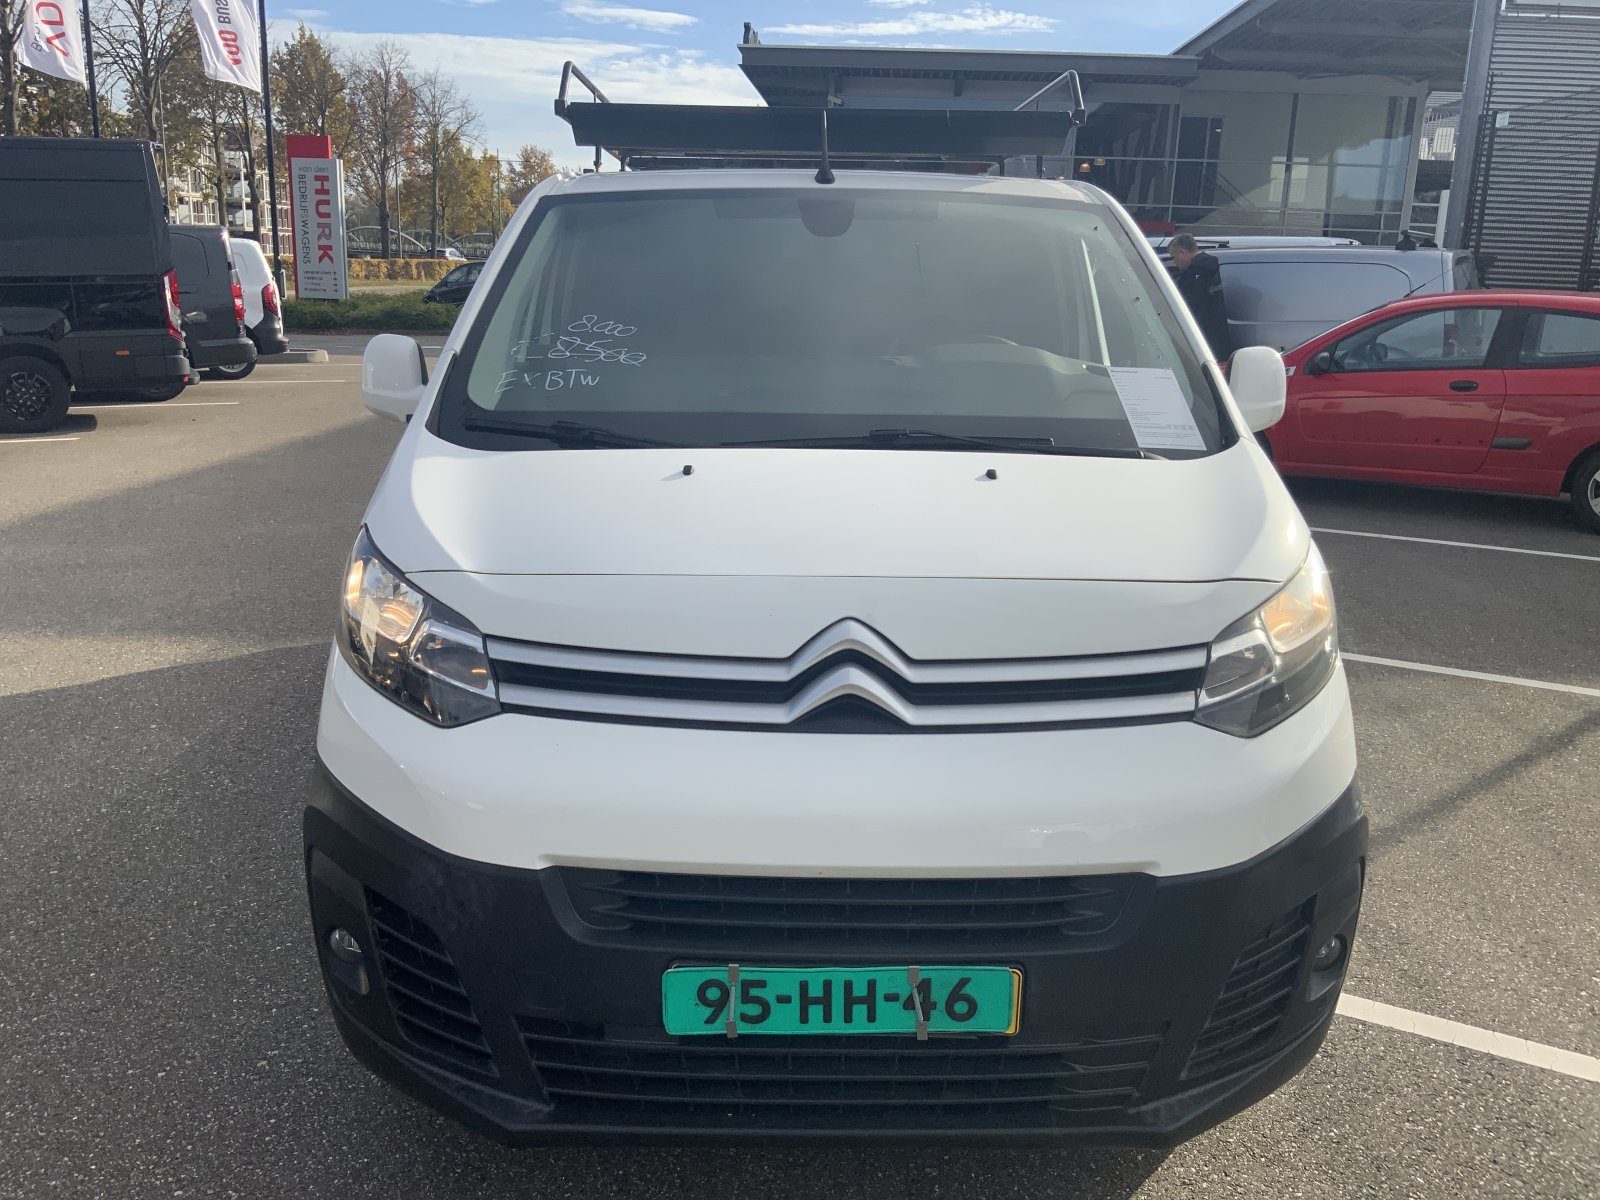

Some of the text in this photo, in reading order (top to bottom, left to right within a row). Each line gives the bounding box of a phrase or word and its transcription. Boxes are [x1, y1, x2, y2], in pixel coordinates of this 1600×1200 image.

[298, 174, 311, 264] BEDRIJFSWAGENS
[314, 175, 334, 264] HURK
[696, 977, 979, 1025] 95-HH-46
